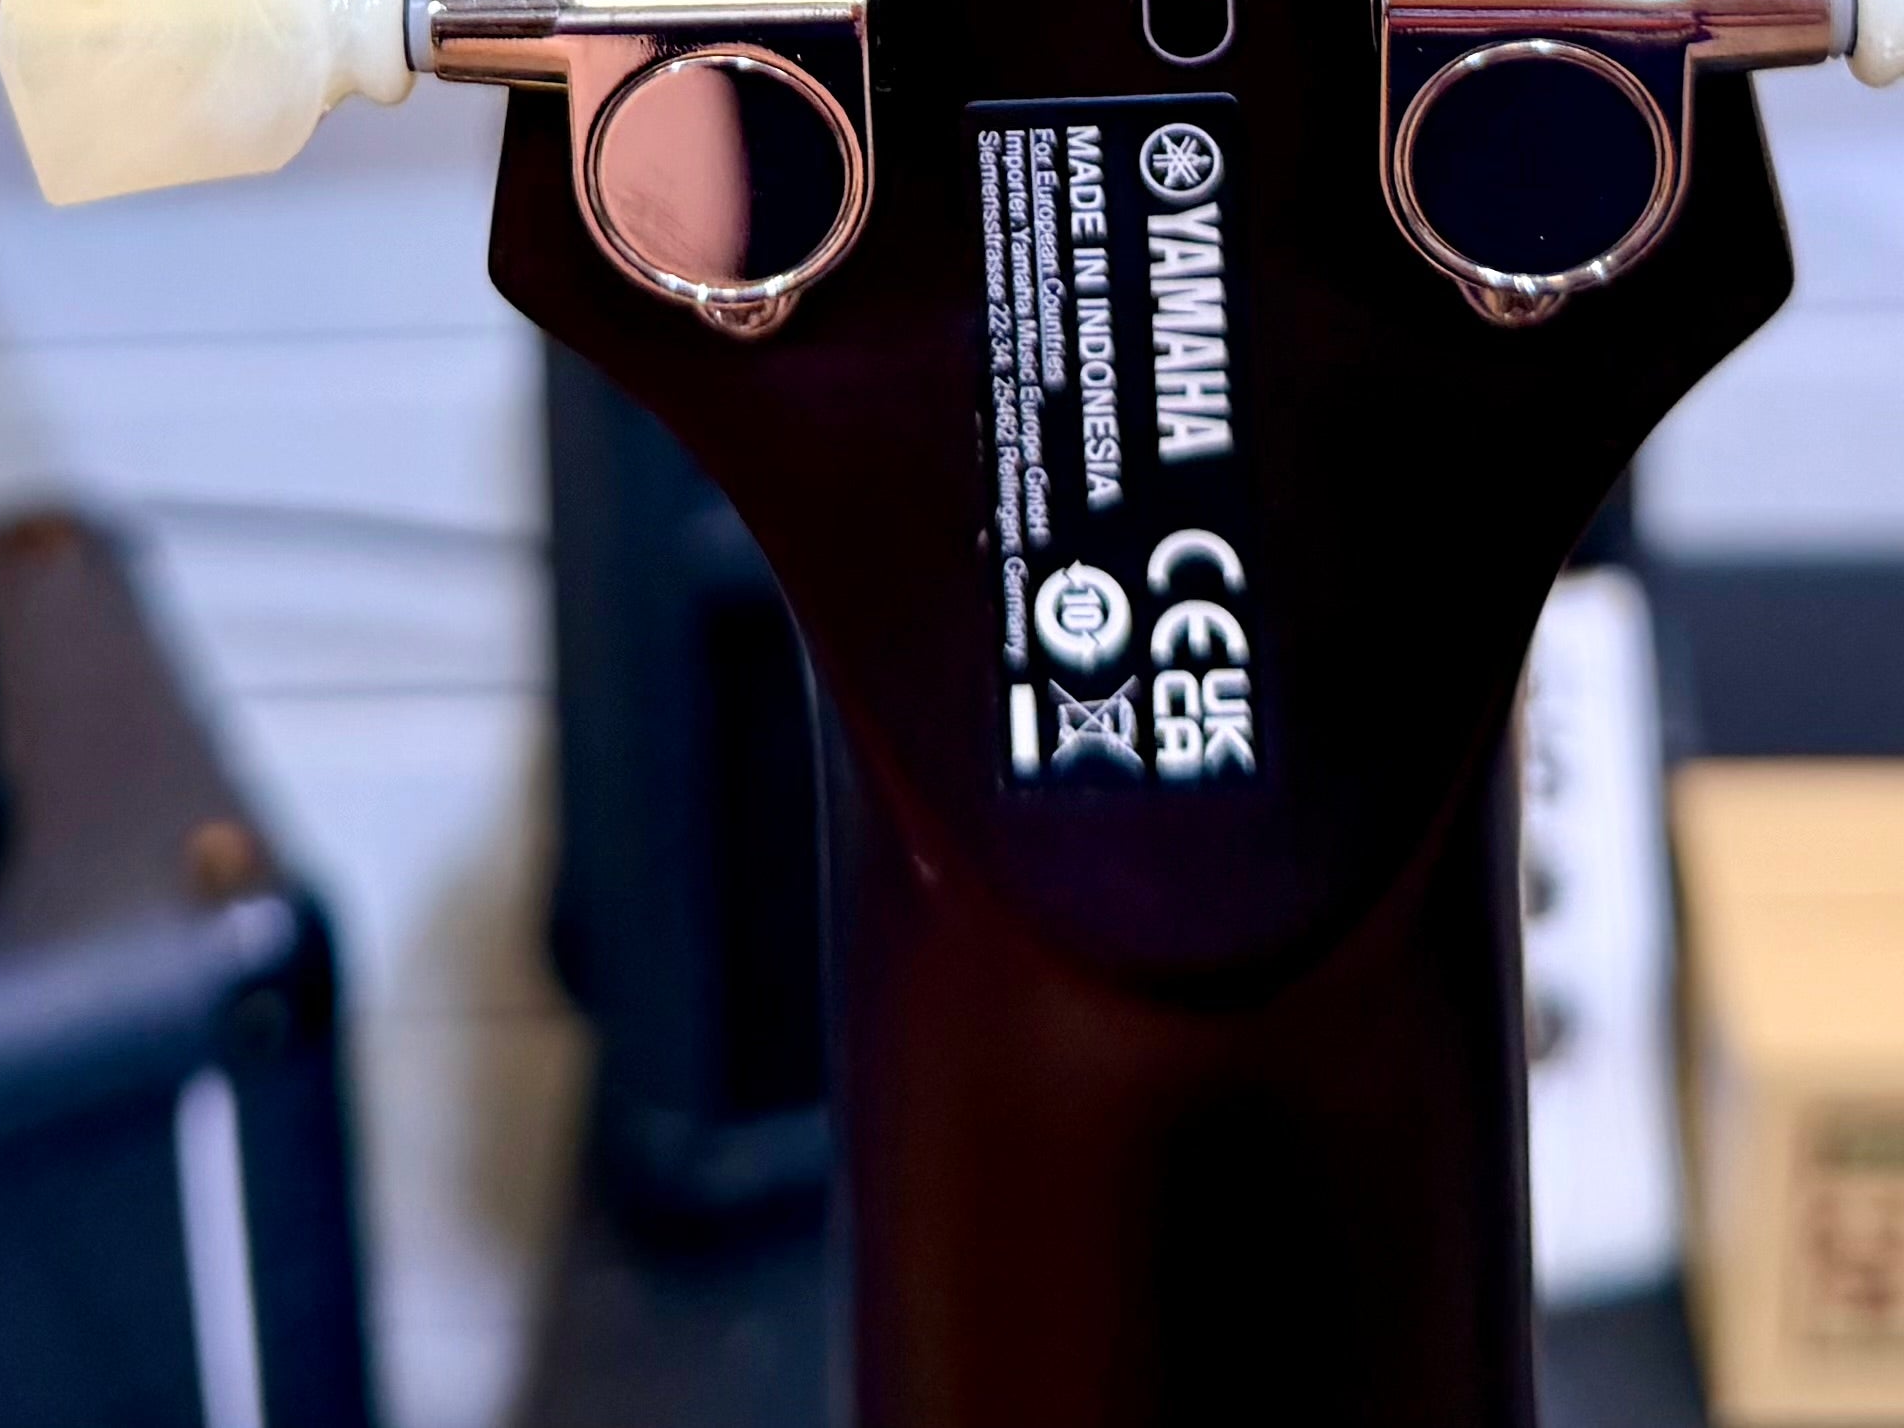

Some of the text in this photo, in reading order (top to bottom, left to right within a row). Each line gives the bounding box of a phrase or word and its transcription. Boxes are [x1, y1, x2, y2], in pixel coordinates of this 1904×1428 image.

[1031, 128, 1067, 387] For European Countries
[1015, 320, 1039, 382] Music
[1066, 125, 1122, 511] MADE IN INDONESIA
[1146, 201, 1234, 462] YAMAHA
[1017, 386, 1044, 462] Europe
[1026, 467, 1050, 544] GmbH
[1002, 556, 1029, 668] Germany
